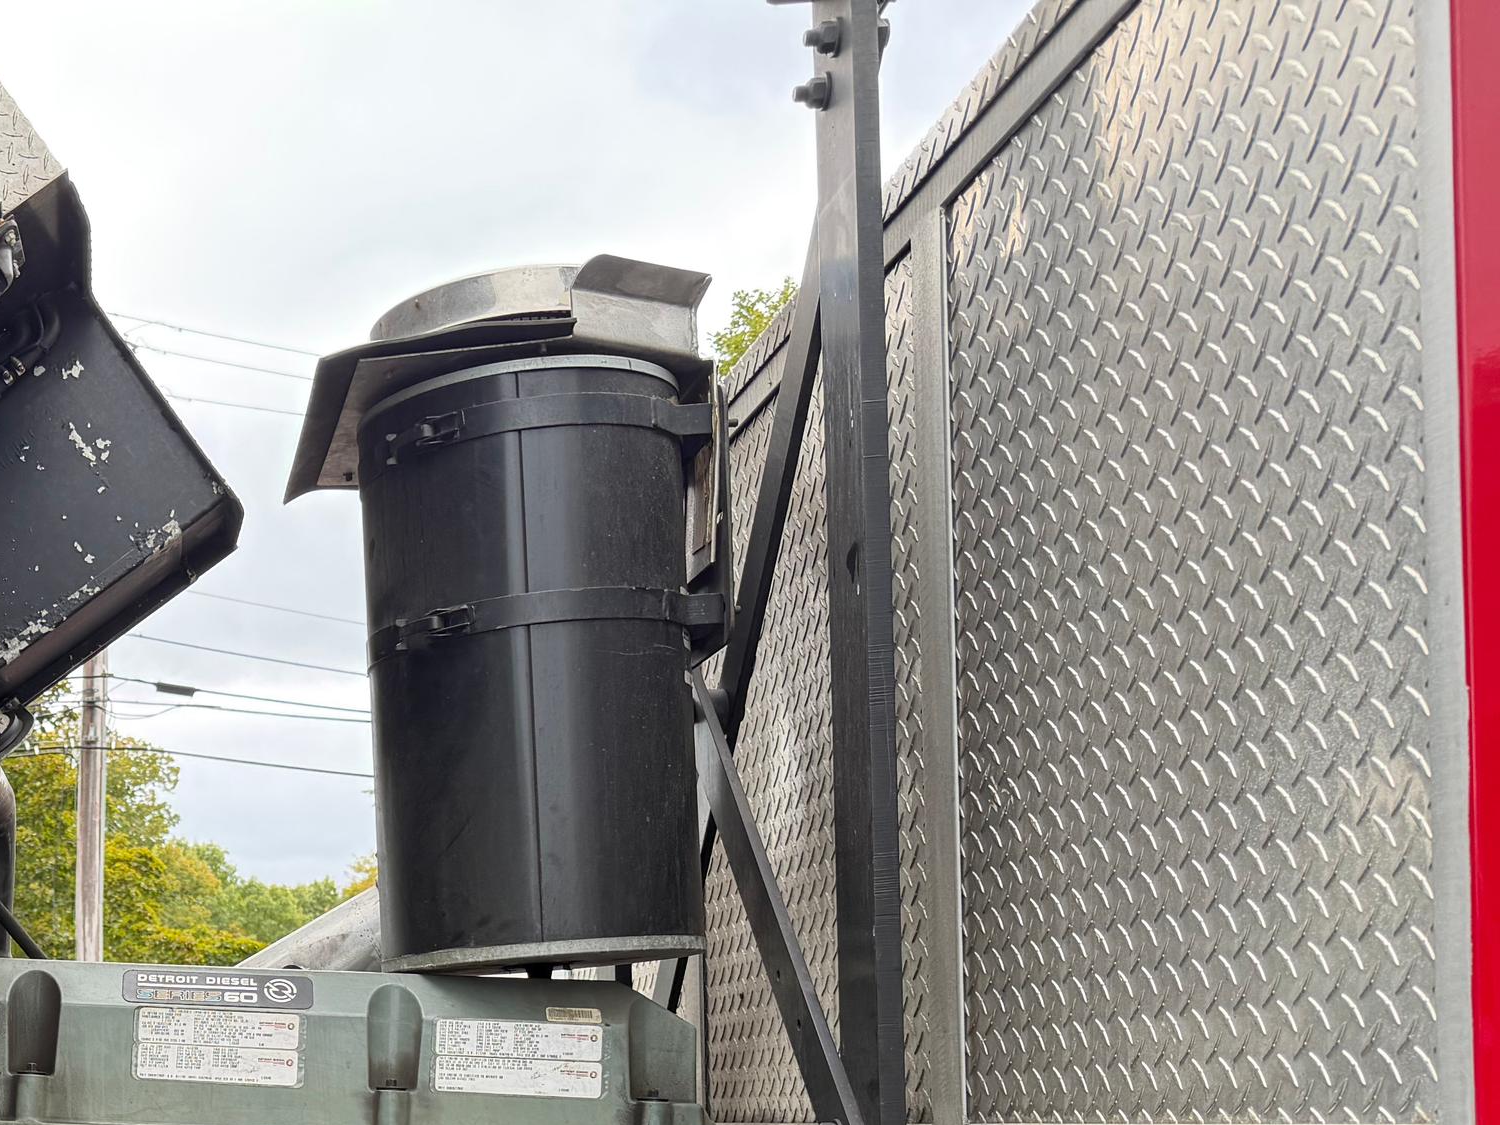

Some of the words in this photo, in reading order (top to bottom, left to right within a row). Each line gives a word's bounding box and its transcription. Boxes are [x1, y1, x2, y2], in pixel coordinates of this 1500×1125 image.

[137, 973, 199, 984] DETROIT
[205, 976, 258, 986] DIESEL
[223, 991, 258, 1003] 60
